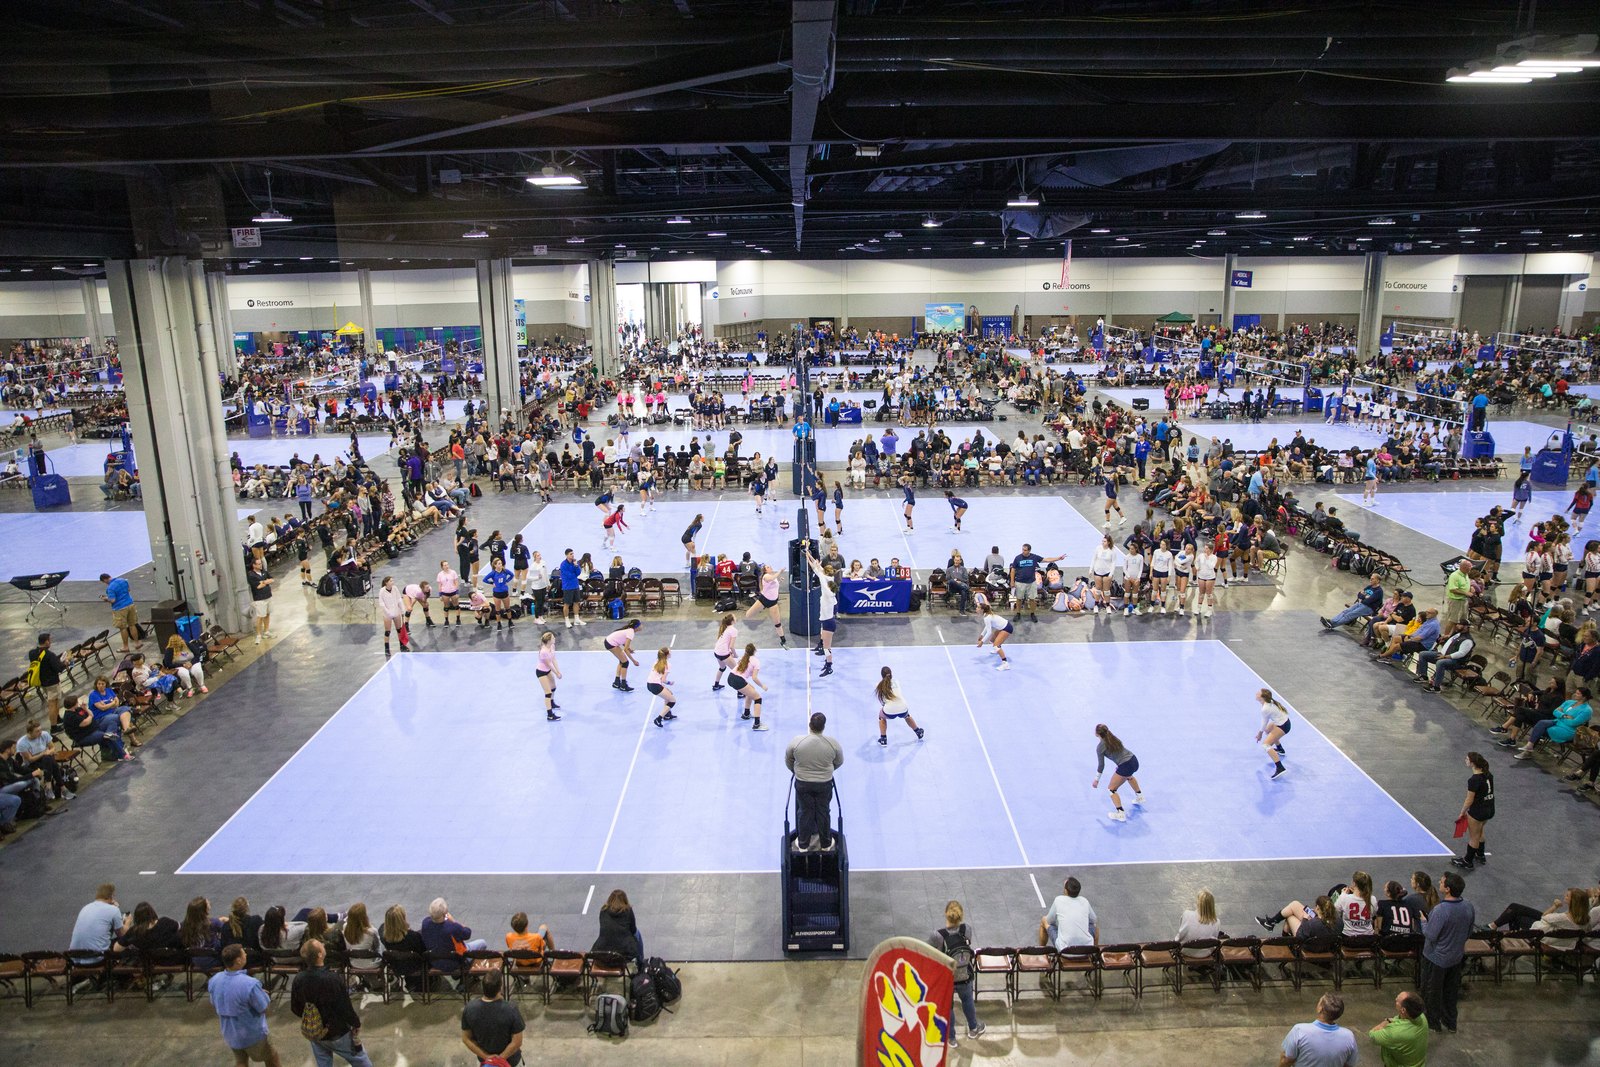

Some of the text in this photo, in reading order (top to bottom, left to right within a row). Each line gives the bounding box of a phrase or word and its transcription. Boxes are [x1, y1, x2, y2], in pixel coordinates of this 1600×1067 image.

[886, 568, 896, 576] 10
[901, 568, 911, 576] 03
[1349, 903, 1370, 920] 24
[1391, 906, 1410, 926] 10
